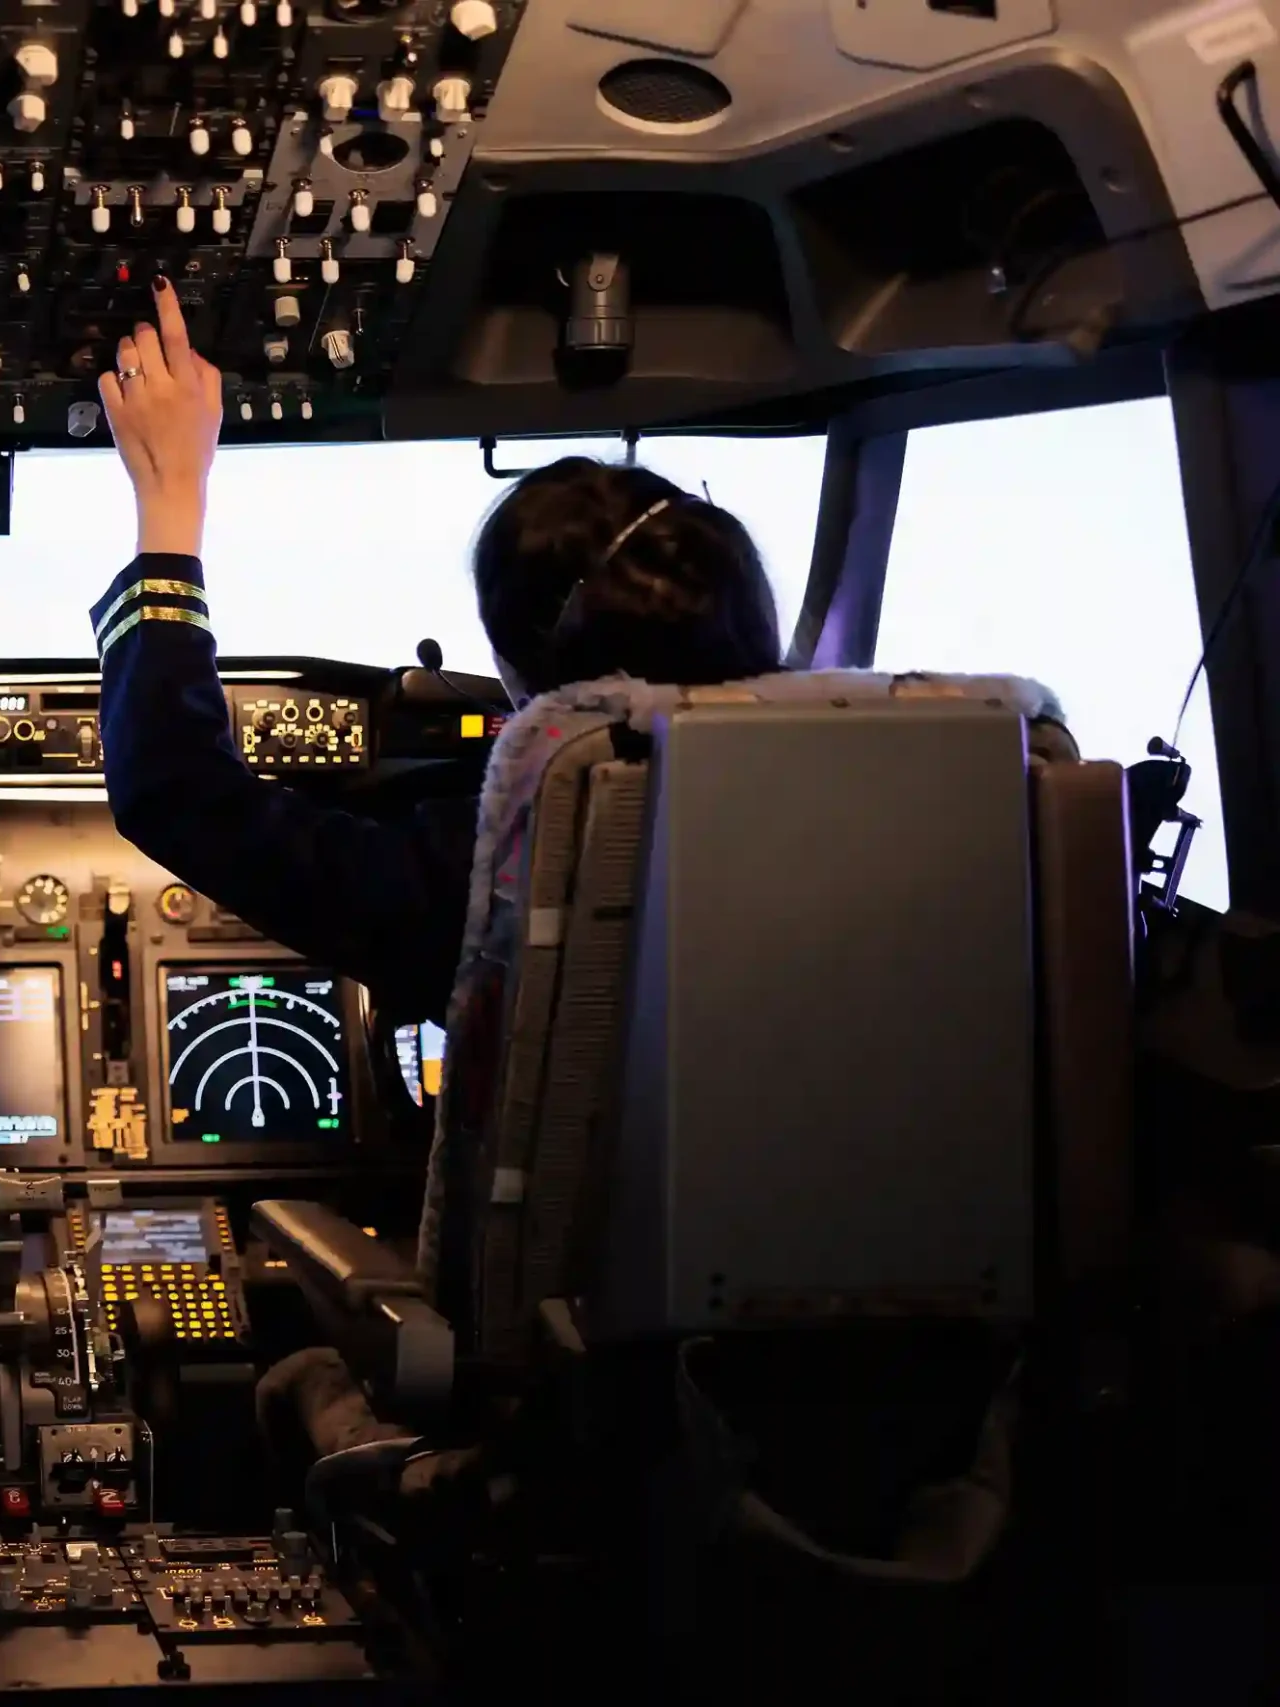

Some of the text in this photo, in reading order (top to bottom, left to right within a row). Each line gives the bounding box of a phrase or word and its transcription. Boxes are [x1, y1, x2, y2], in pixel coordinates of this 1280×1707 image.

[54, 1326, 68, 1336] 25
[56, 1348, 71, 1359] 30
[57, 1376, 72, 1387] 40
